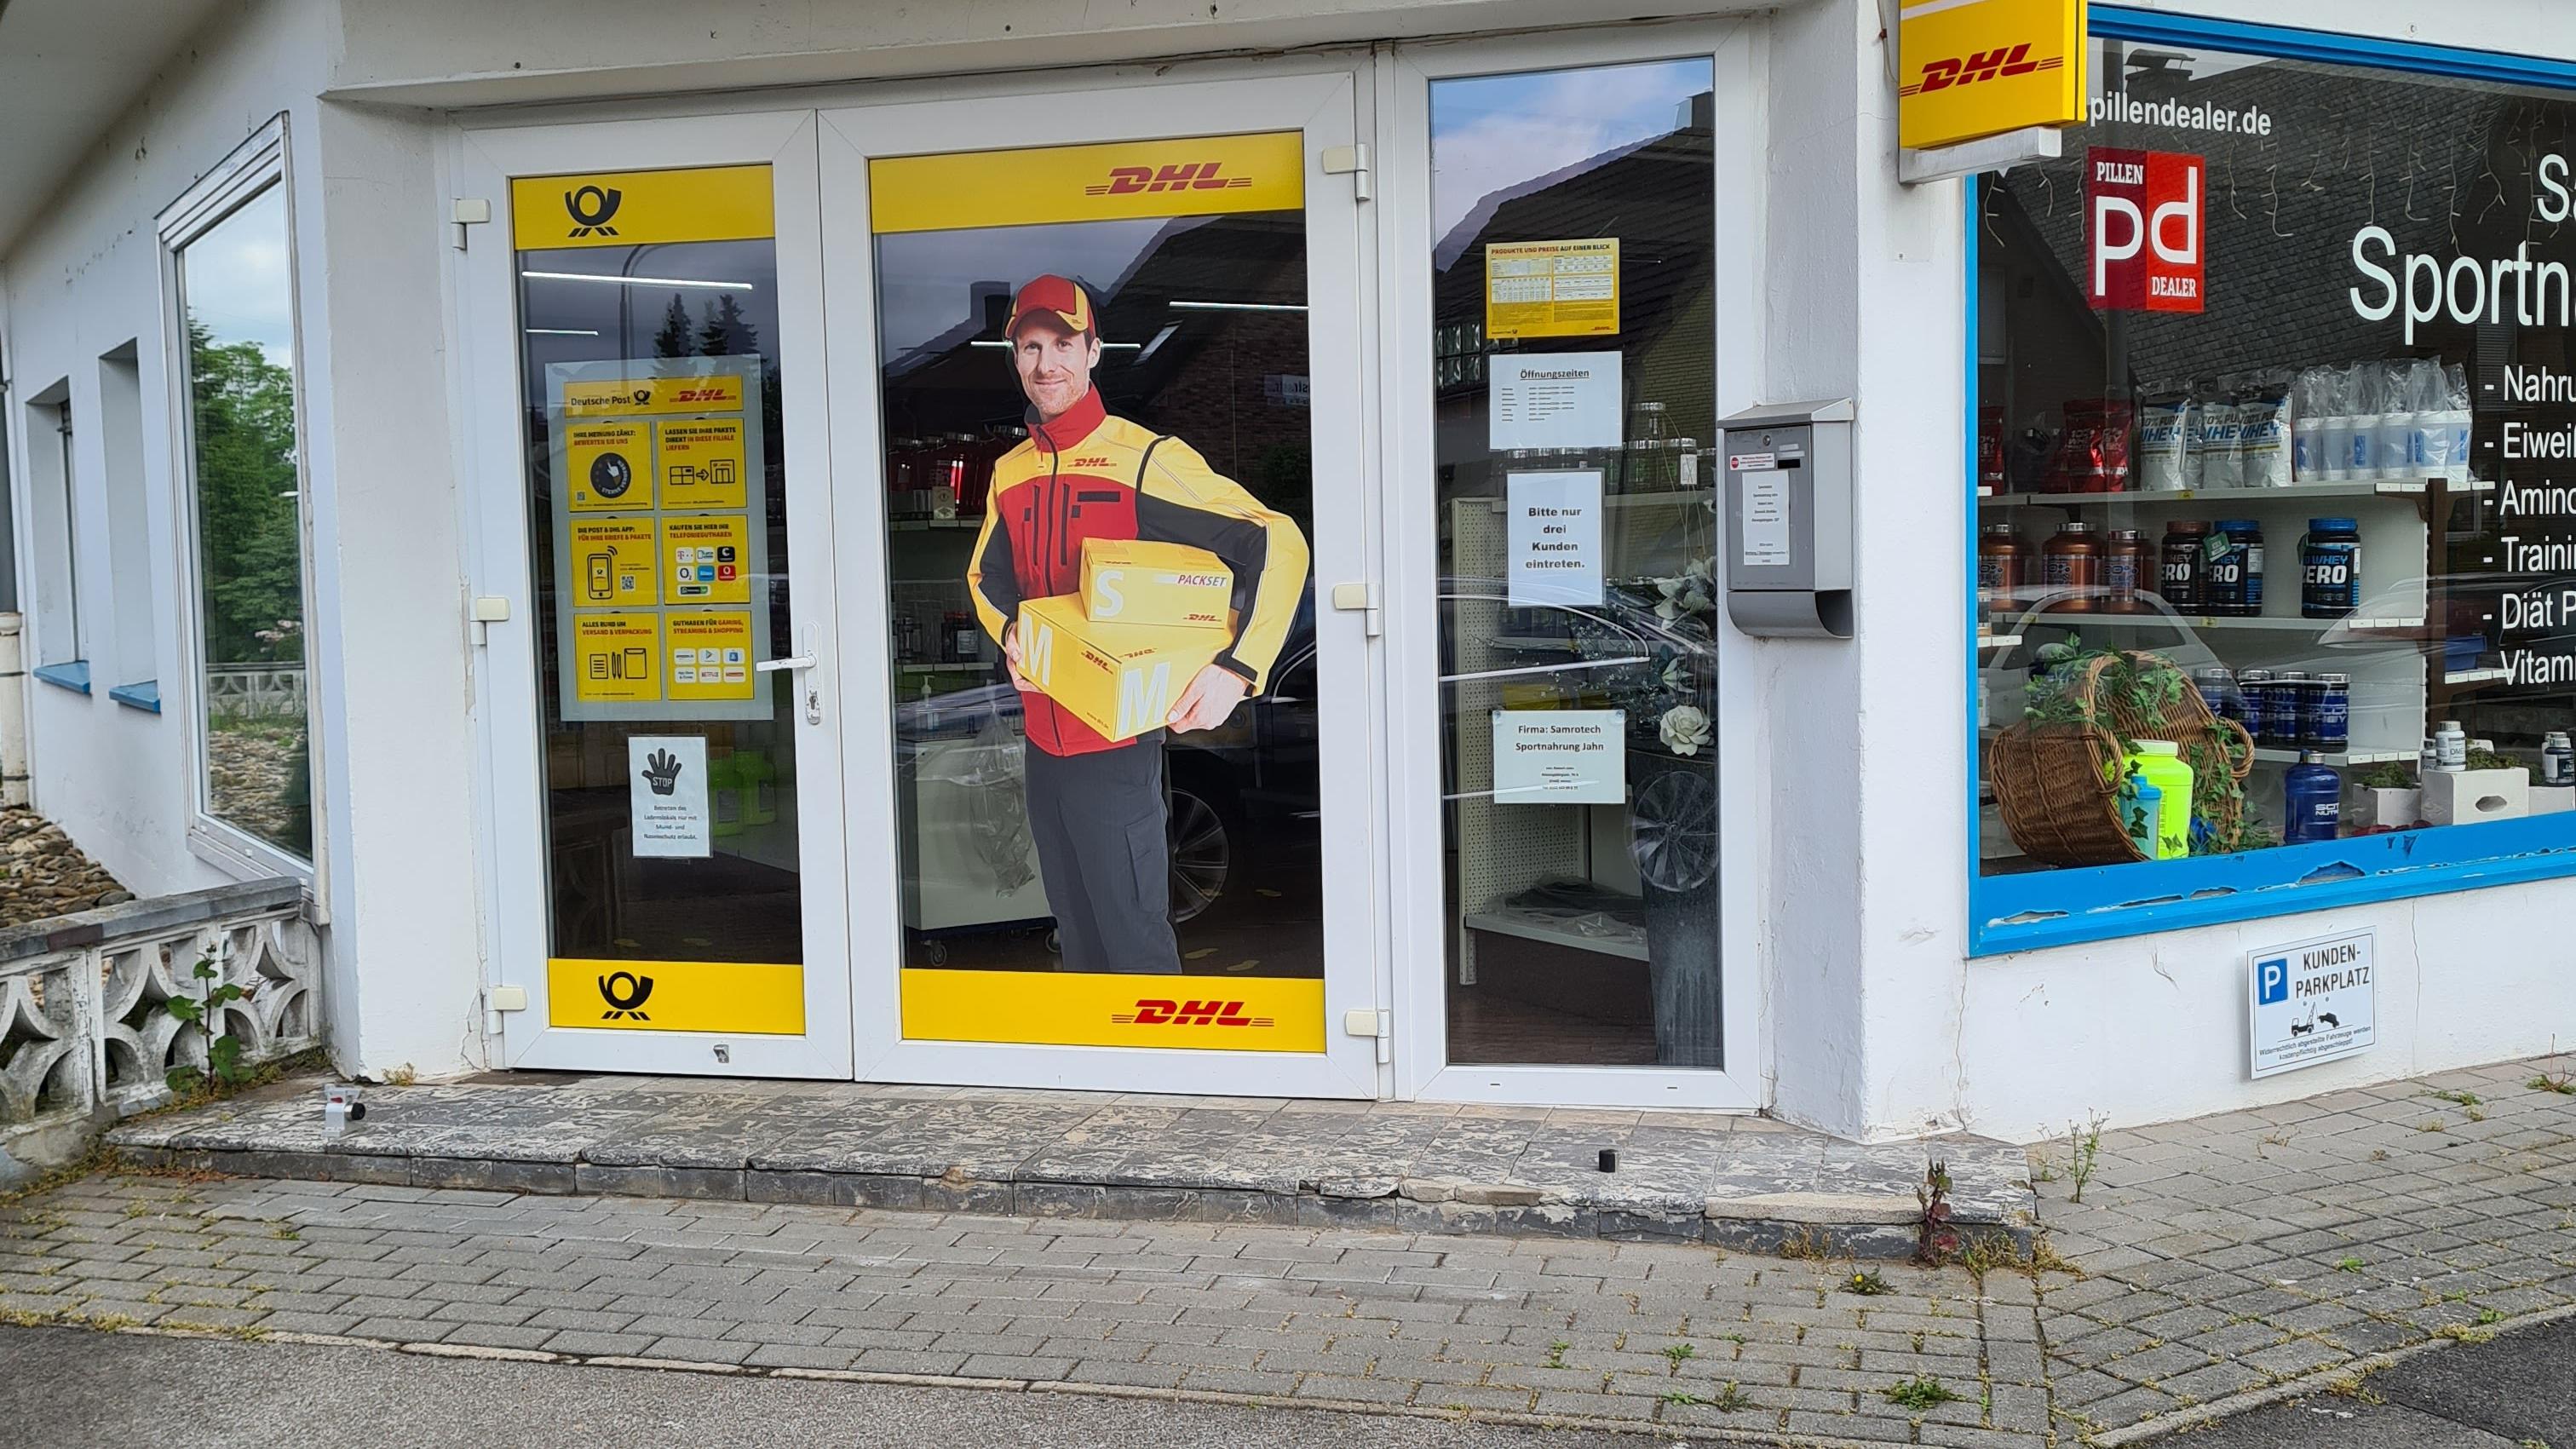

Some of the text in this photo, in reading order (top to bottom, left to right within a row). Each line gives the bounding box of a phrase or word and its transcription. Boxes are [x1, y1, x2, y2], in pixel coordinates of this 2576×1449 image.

[1920, 43, 2039, 94] DHL
[2090, 87, 2271, 135] pillendealer.de
[1108, 162, 1229, 194] DHL
[2096, 162, 2143, 185] PILLEN
[2537, 153, 2576, 222] S
[2152, 276, 2197, 297] DEALER
[2349, 226, 2576, 345] Sportn
[1521, 368, 1590, 379] Öffnungszeiten
[571, 397, 610, 406] Deutsche
[678, 388, 727, 402] DHL
[2504, 422, 2576, 458] Eiwei
[1074, 457, 1109, 467] DHL
[1528, 507, 1558, 517] Bitte
[1543, 525, 1567, 534] drei
[1532, 542, 1578, 551] Kunden
[1526, 559, 1585, 568] eintreten.
[1095, 570, 1227, 617] S PACKSET
[1188, 613, 1217, 622] DHL
[2502, 591, 2554, 629] Diät
[1019, 612, 1053, 687] M
[1084, 650, 1111, 671] DHL
[2500, 649, 2576, 686] Vitam
[1118, 661, 1170, 735] M
[1518, 725, 1601, 733] Firma: Samrotech
[1515, 742, 1604, 752] Sportnahrung Jahn
[653, 777, 672, 787] STOP
[2303, 943, 2360, 971] KUNDEN-
[2264, 966, 2281, 999] P
[2296, 967, 2370, 998] PARKPLATZ
[1133, 999, 1252, 1026] DHL
